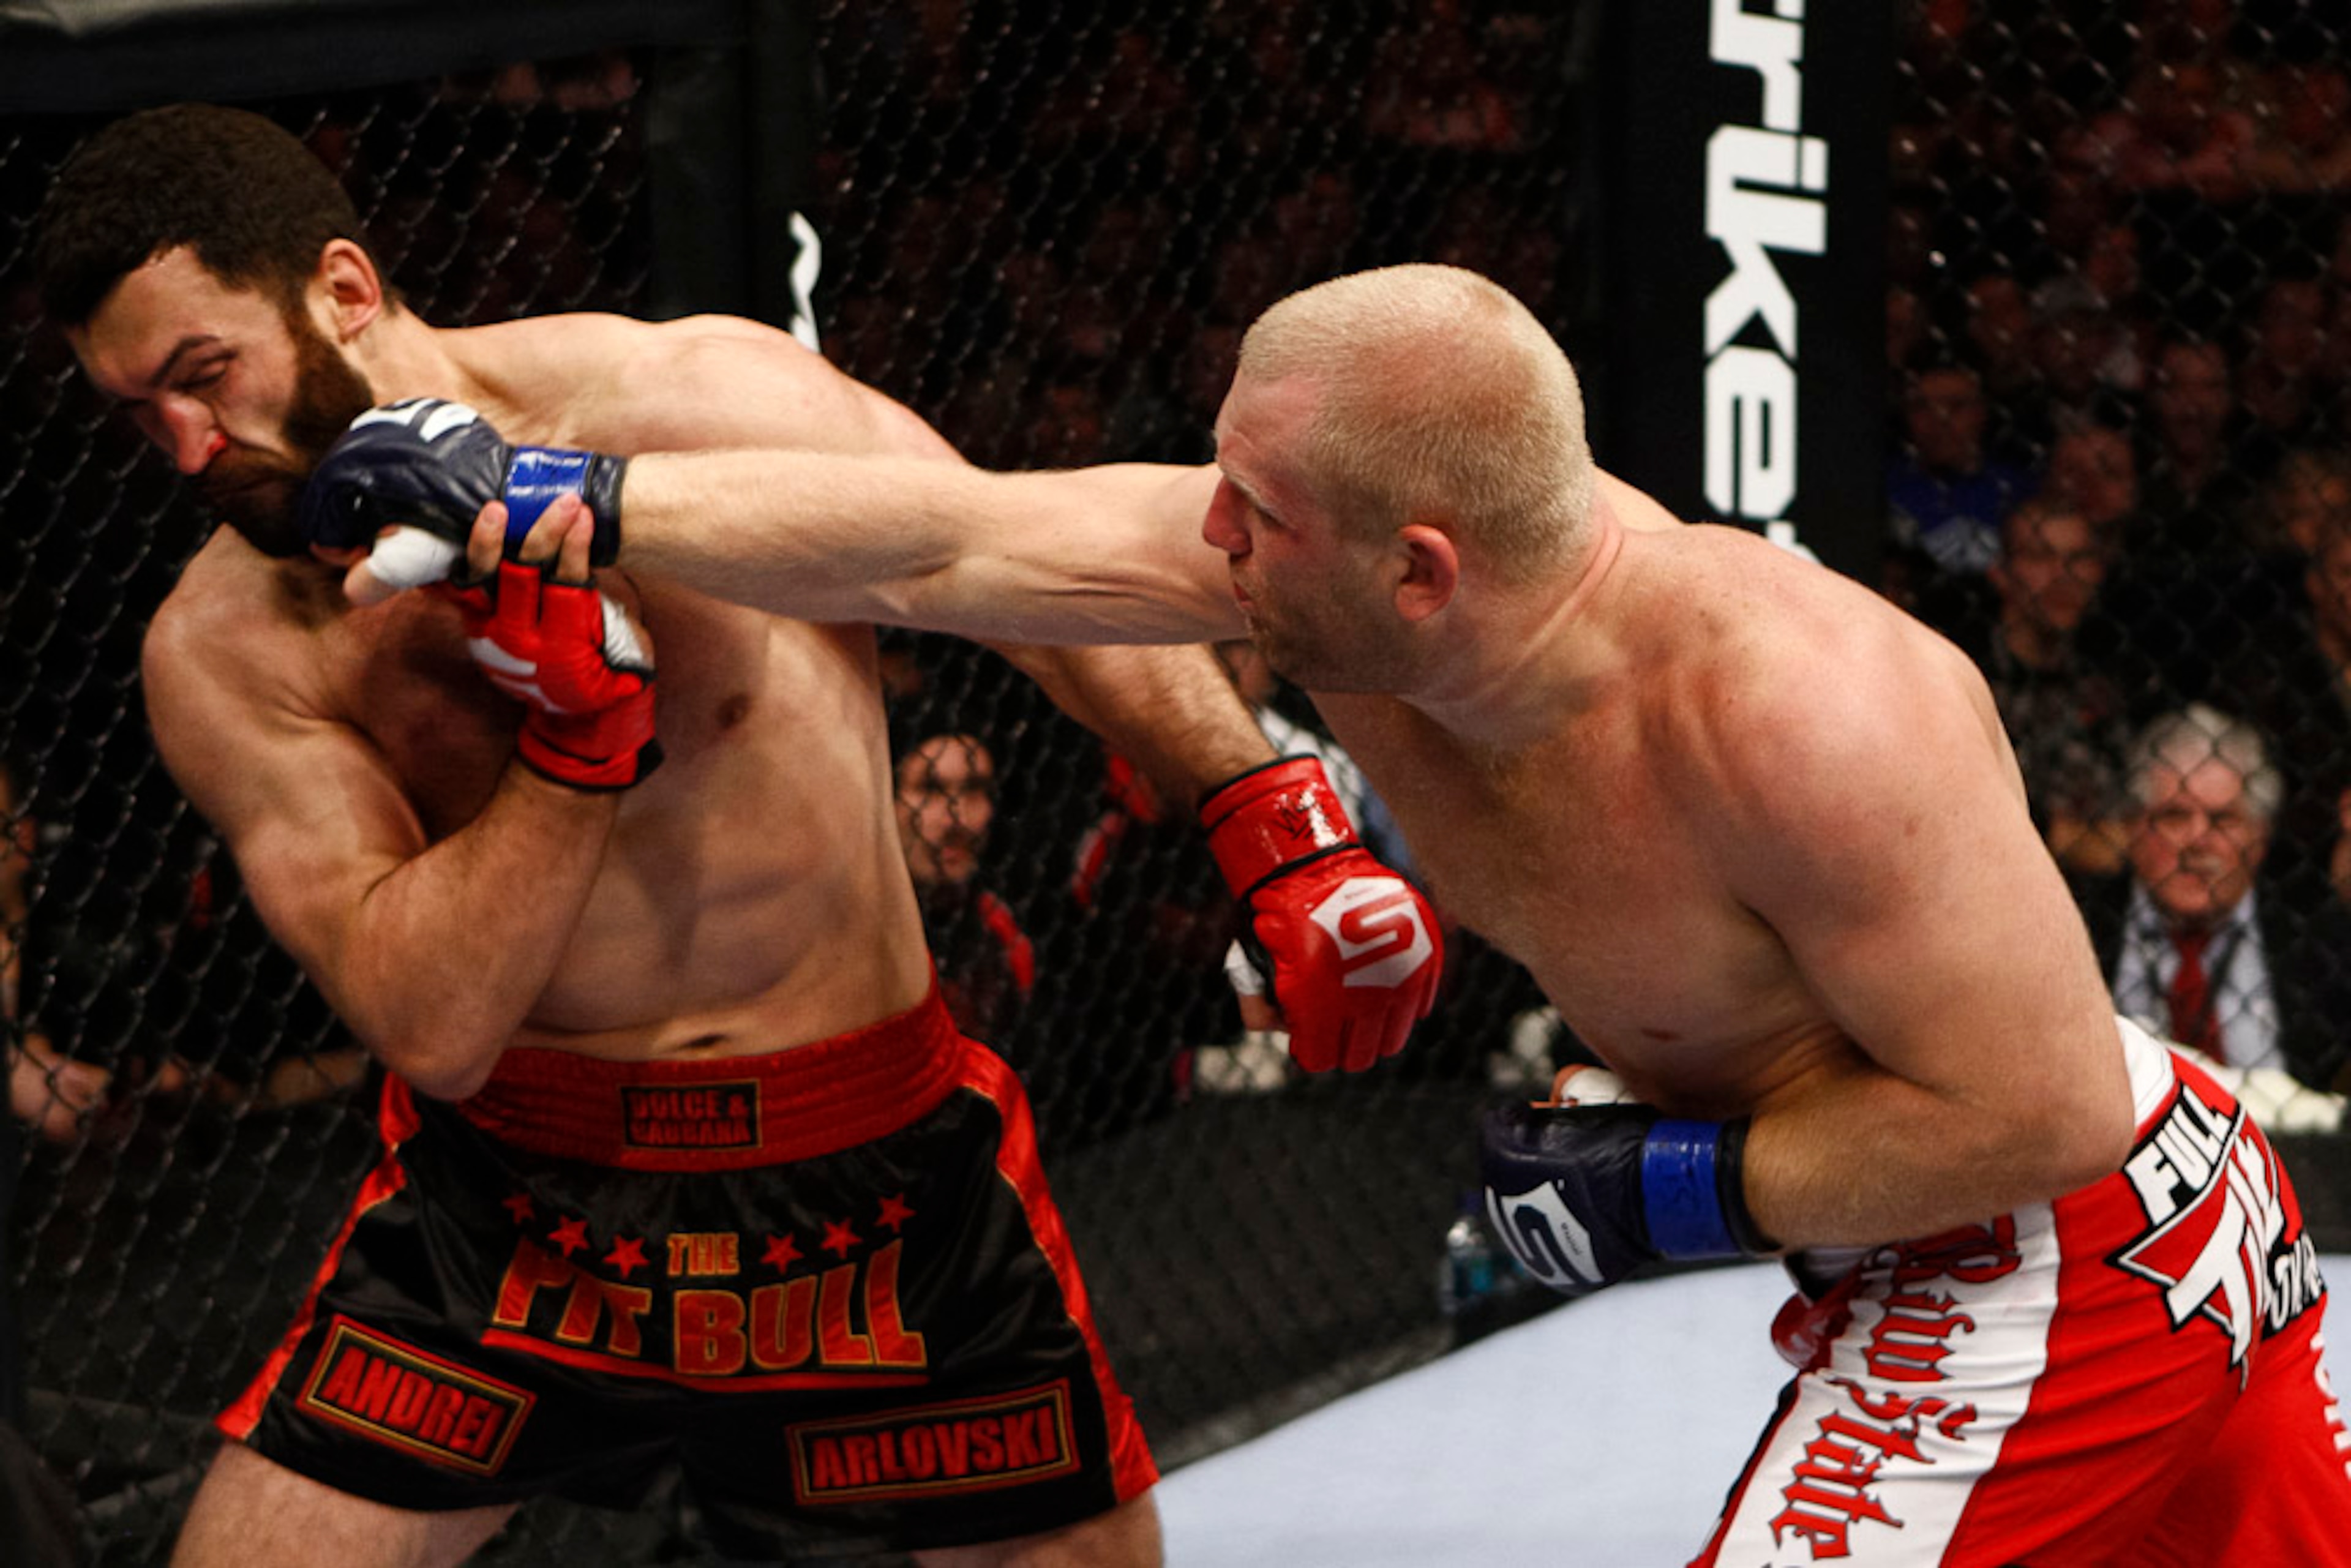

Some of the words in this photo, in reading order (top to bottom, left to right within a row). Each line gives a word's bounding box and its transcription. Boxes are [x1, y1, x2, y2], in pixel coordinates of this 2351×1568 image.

[2125, 1085, 2232, 1226] FULL
[492, 1236, 653, 1357] PIT
[673, 1237, 928, 1376] BULL
[667, 1231, 742, 1277] THE
[320, 1345, 508, 1459] ANDREI
[811, 1405, 1059, 1490] ARLOVSKI
[1768, 1379, 1978, 1560] State
